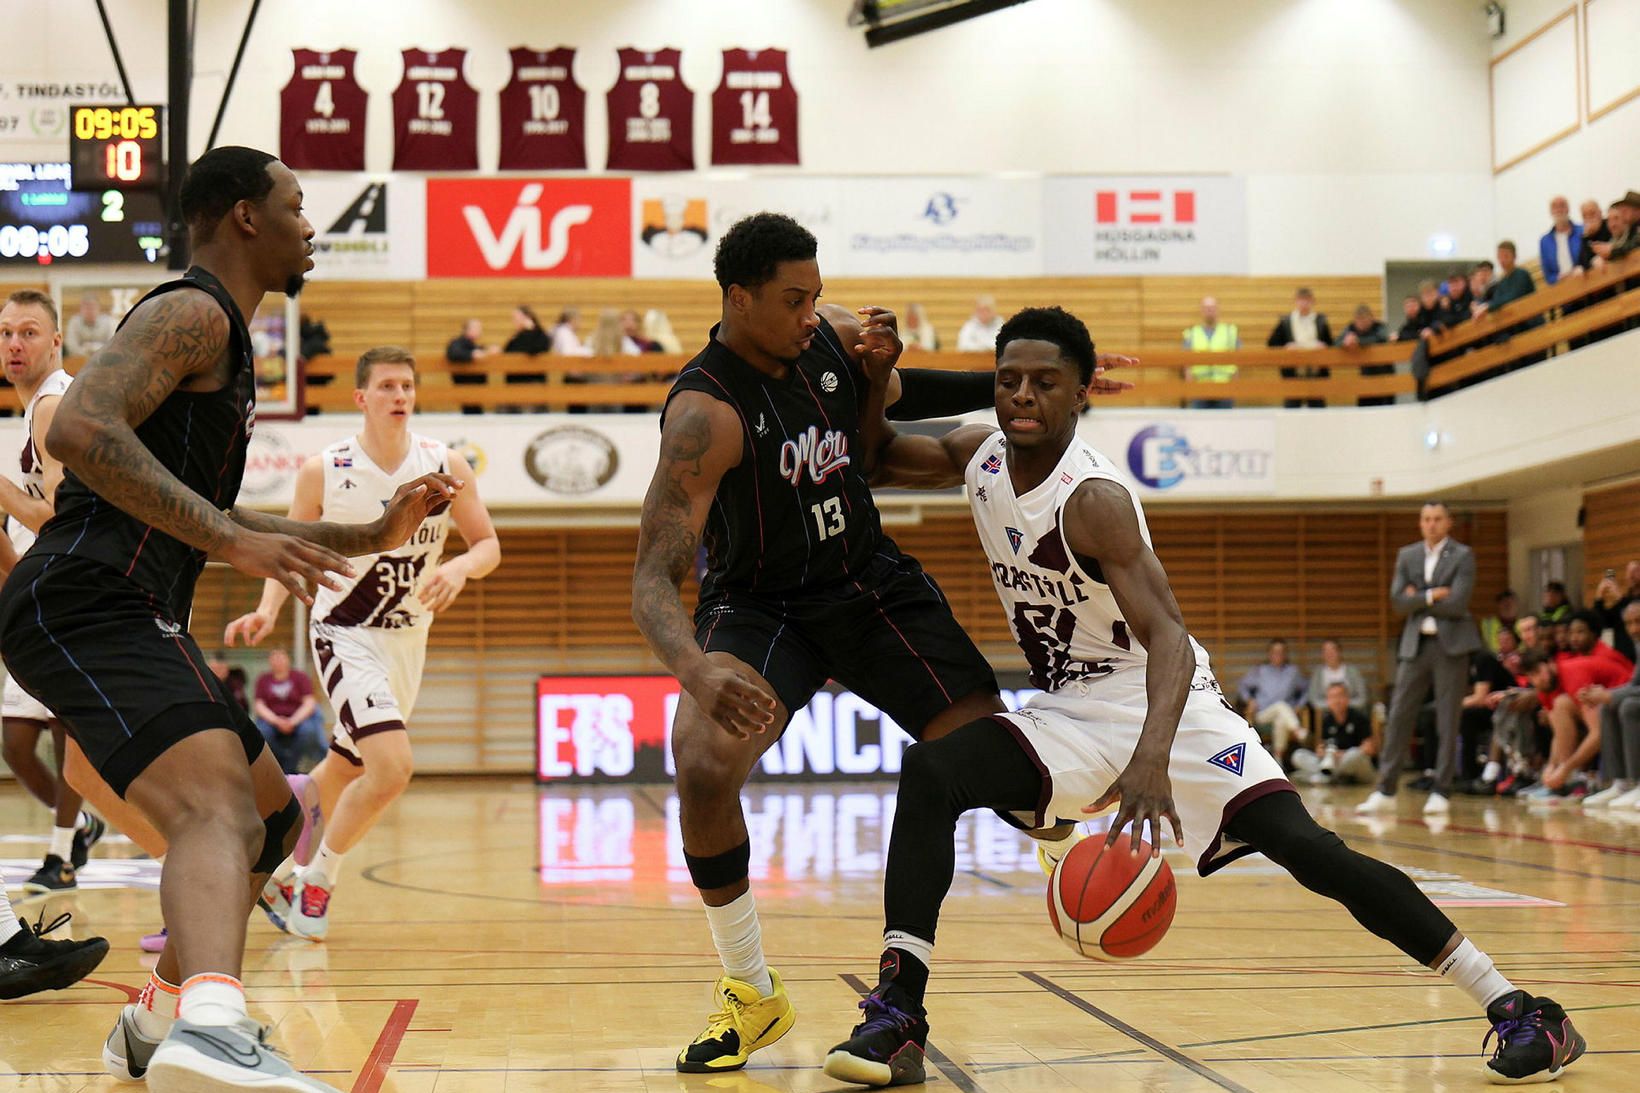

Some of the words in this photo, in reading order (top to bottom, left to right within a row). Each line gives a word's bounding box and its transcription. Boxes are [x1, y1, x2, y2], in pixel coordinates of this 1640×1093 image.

[313, 81, 335, 118] 4
[416, 81, 446, 119] 12
[528, 84, 560, 121] 10
[639, 82, 660, 119] 8
[740, 90, 772, 128] 14
[74, 107, 158, 140] 09:05
[101, 189, 125, 222] 2
[811, 496, 846, 541] 13
[376, 562, 416, 598] 34
